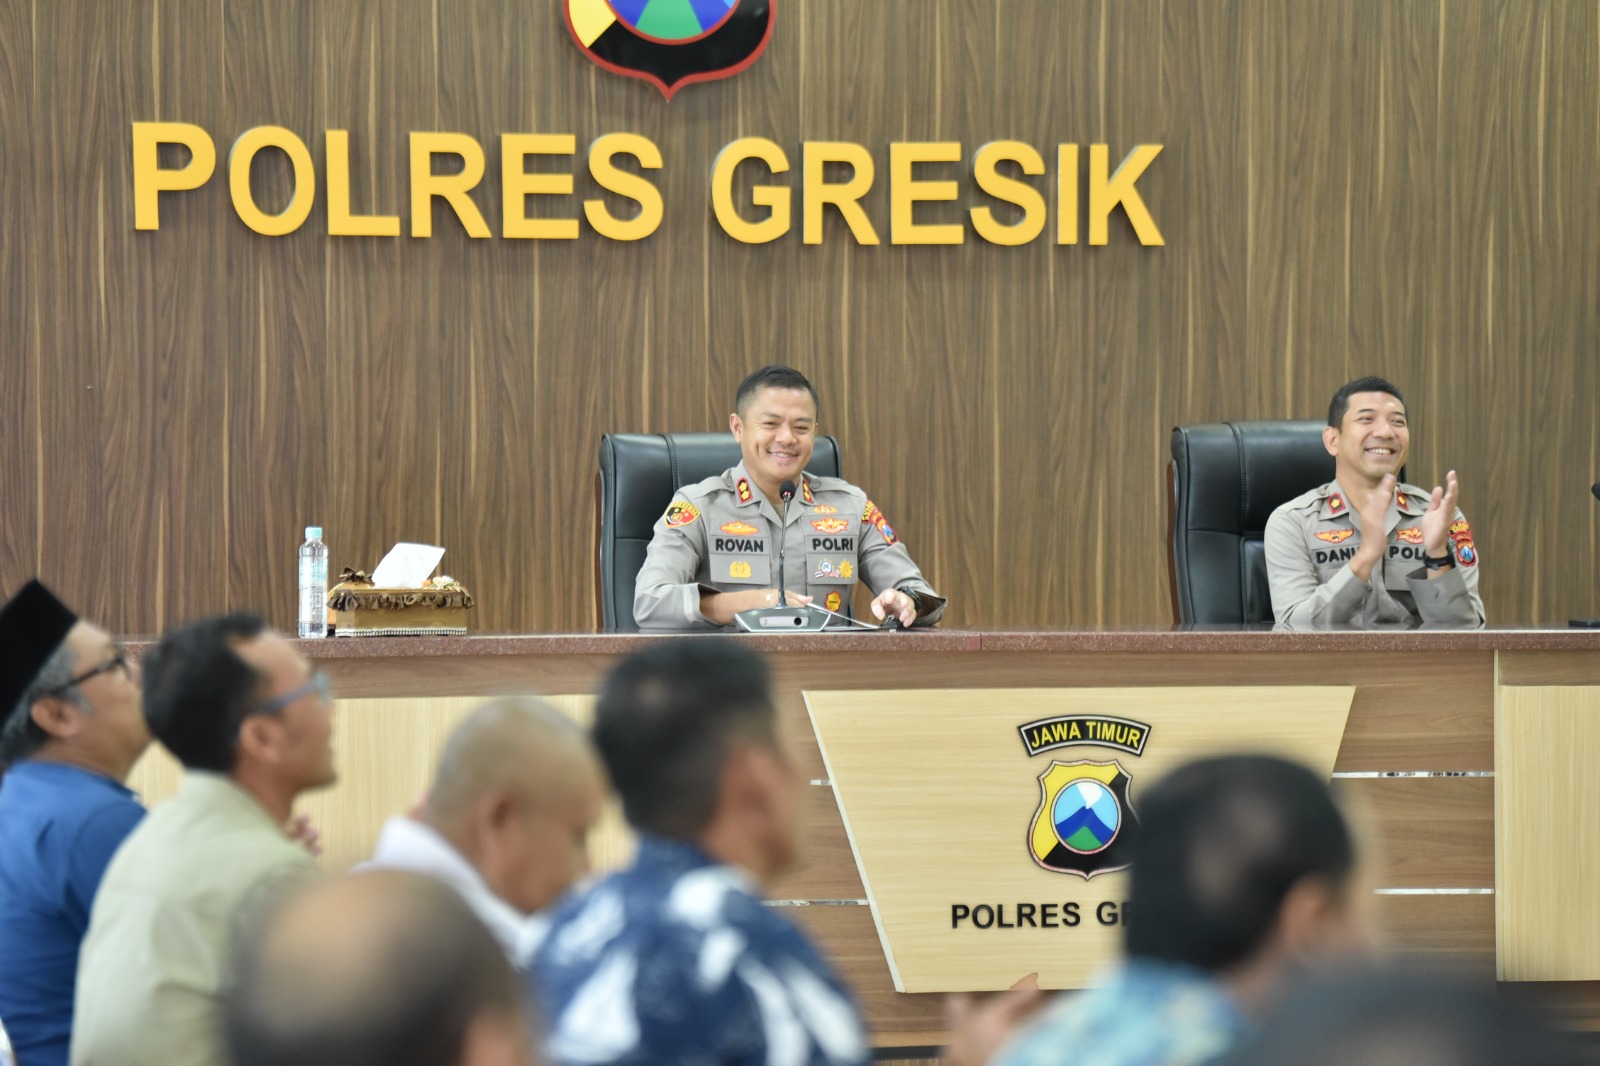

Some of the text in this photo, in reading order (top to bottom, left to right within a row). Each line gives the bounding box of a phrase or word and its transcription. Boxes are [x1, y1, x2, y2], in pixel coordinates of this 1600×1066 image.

[132, 121, 1165, 246] POLRES GRESIK
[715, 538, 764, 553] ROVAN
[812, 537, 853, 552] POLRI
[1315, 546, 1360, 564] DANI
[1031, 721, 1141, 748] JAWA TIMUR
[951, 902, 1081, 929] POLRES
